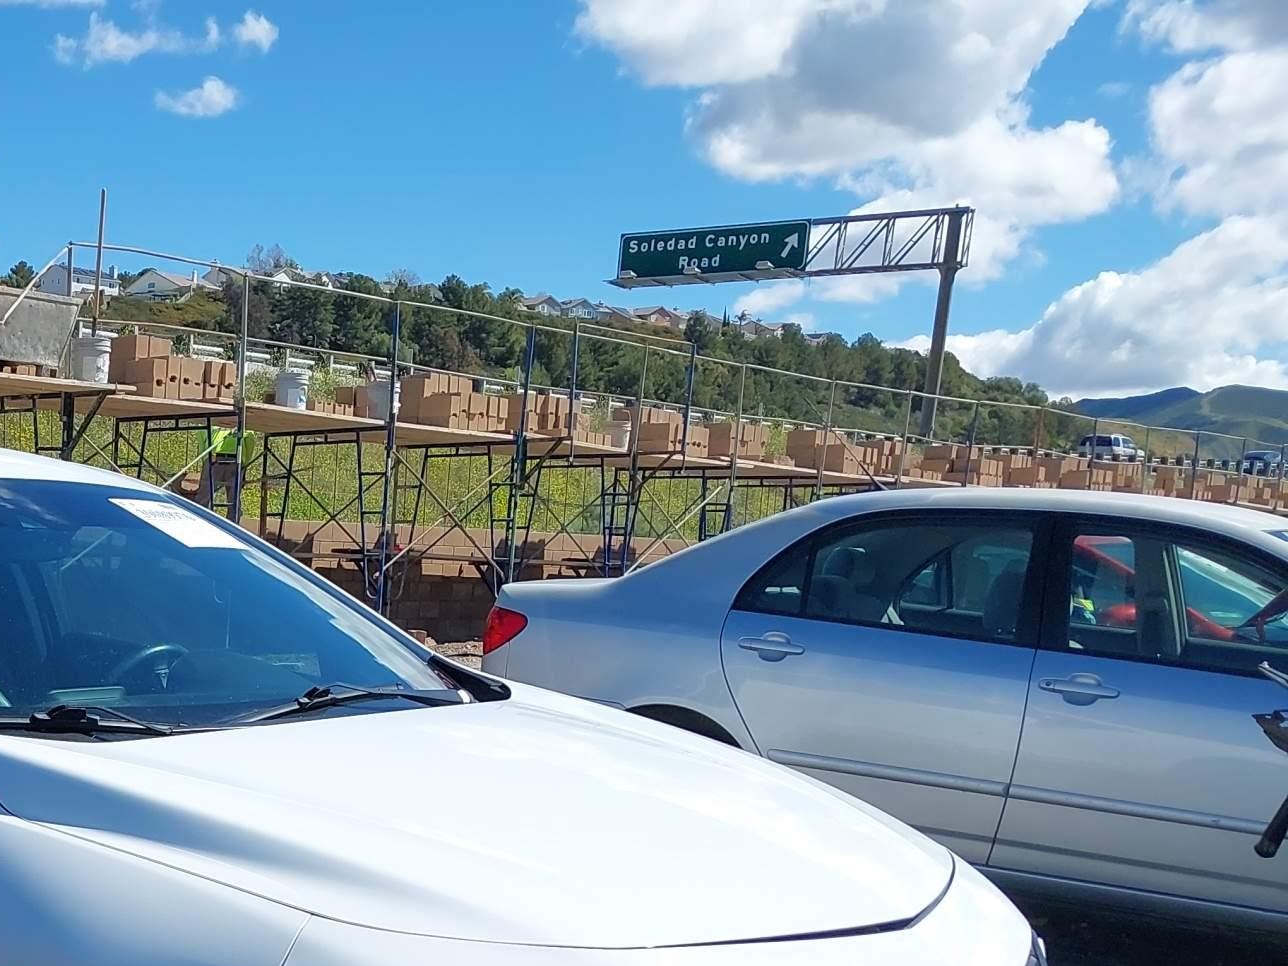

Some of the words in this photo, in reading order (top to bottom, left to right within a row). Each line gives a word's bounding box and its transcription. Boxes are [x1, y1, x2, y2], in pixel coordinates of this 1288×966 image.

[629, 236, 697, 253] Soledad
[705, 233, 770, 250] Canyon
[678, 254, 720, 269] Road
